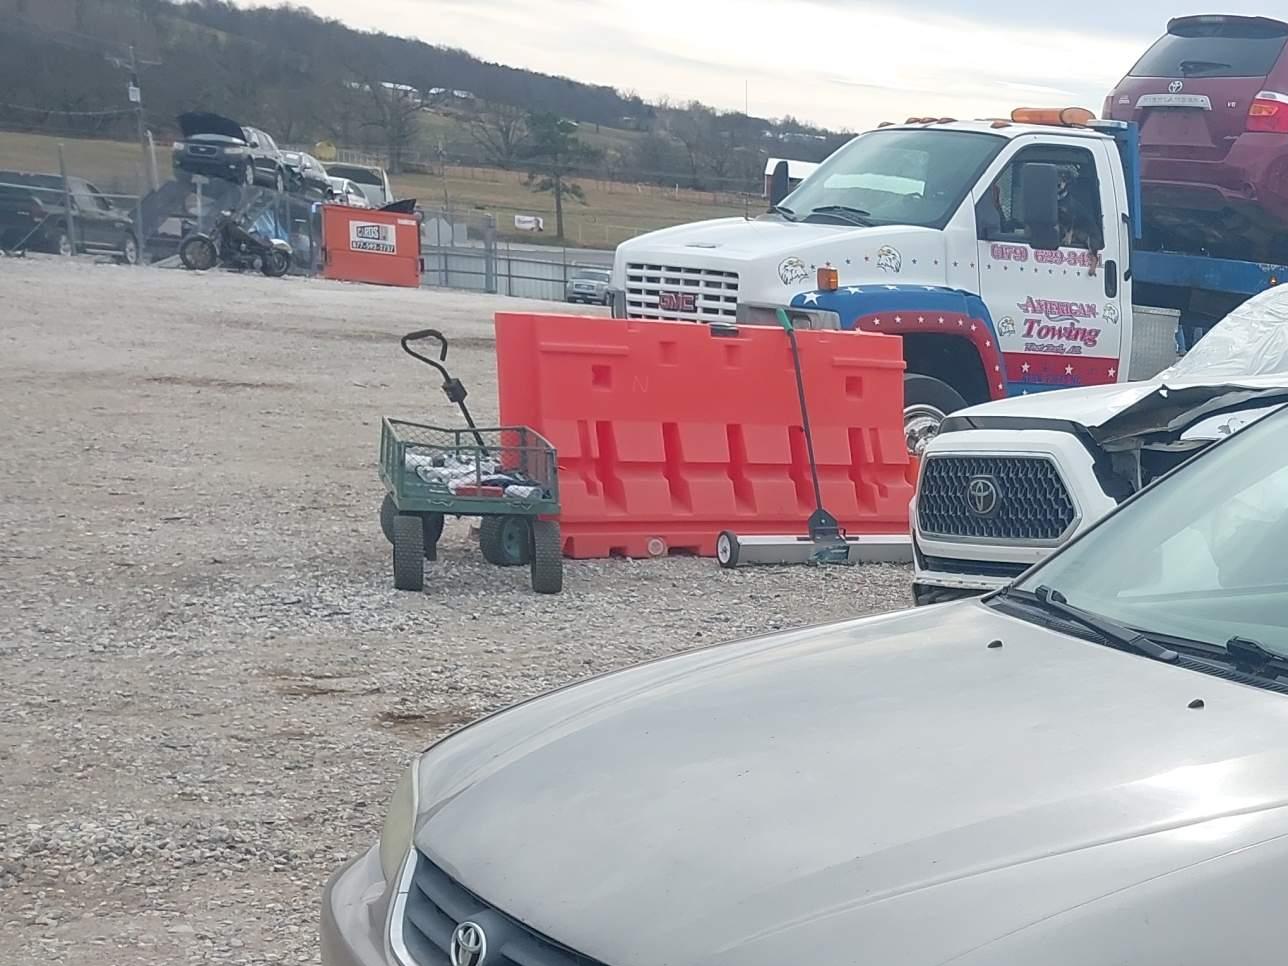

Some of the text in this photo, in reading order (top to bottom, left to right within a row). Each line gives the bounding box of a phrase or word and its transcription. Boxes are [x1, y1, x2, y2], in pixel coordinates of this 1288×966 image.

[1034, 249, 1104, 268] 629-341
[660, 293, 695, 310] GMC
[1017, 296, 1099, 318] AMERICAN
[1022, 318, 1101, 347] Towing
